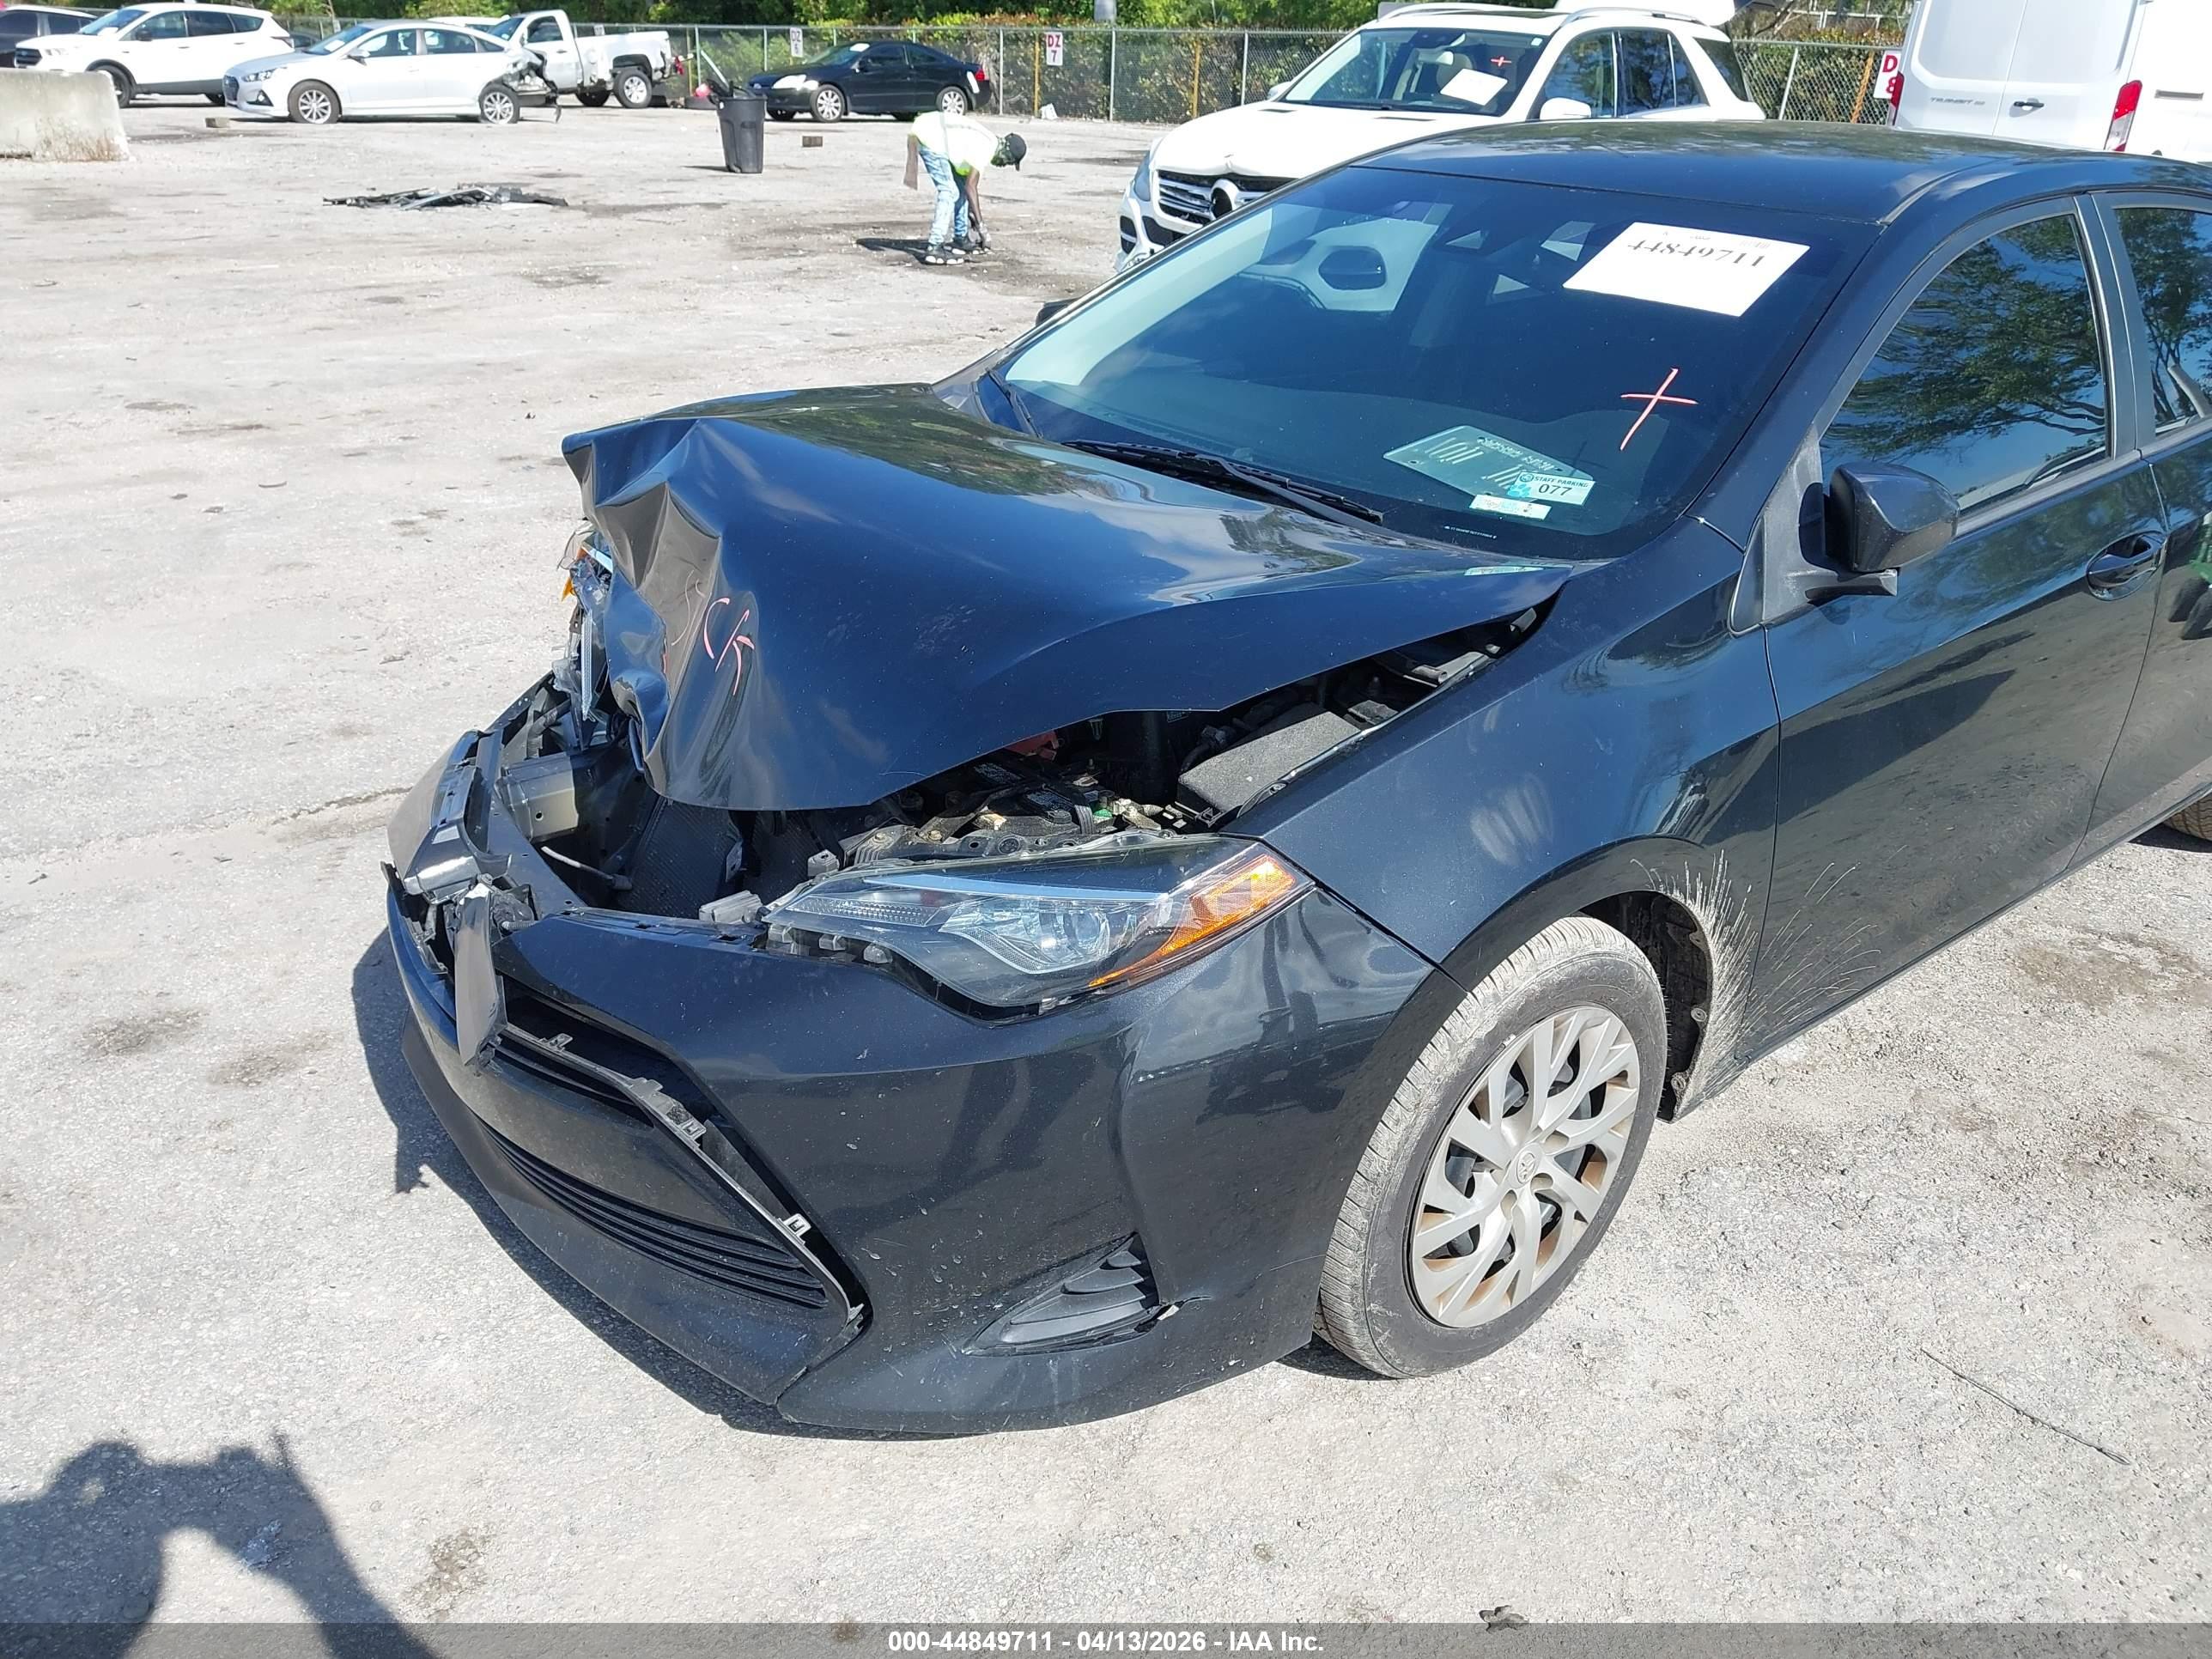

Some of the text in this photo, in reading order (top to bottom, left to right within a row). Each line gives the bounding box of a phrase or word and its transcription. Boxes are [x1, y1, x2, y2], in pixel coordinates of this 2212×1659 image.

[1048, 34, 1061, 47] DZ
[1051, 50, 1057, 63] 7
[1882, 54, 1899, 73] D
[1627, 239, 1765, 267] 44849711
[1534, 475, 1555, 484] STAFF
[1557, 478, 1589, 489] PARKING
[1538, 483, 1572, 496] 077
